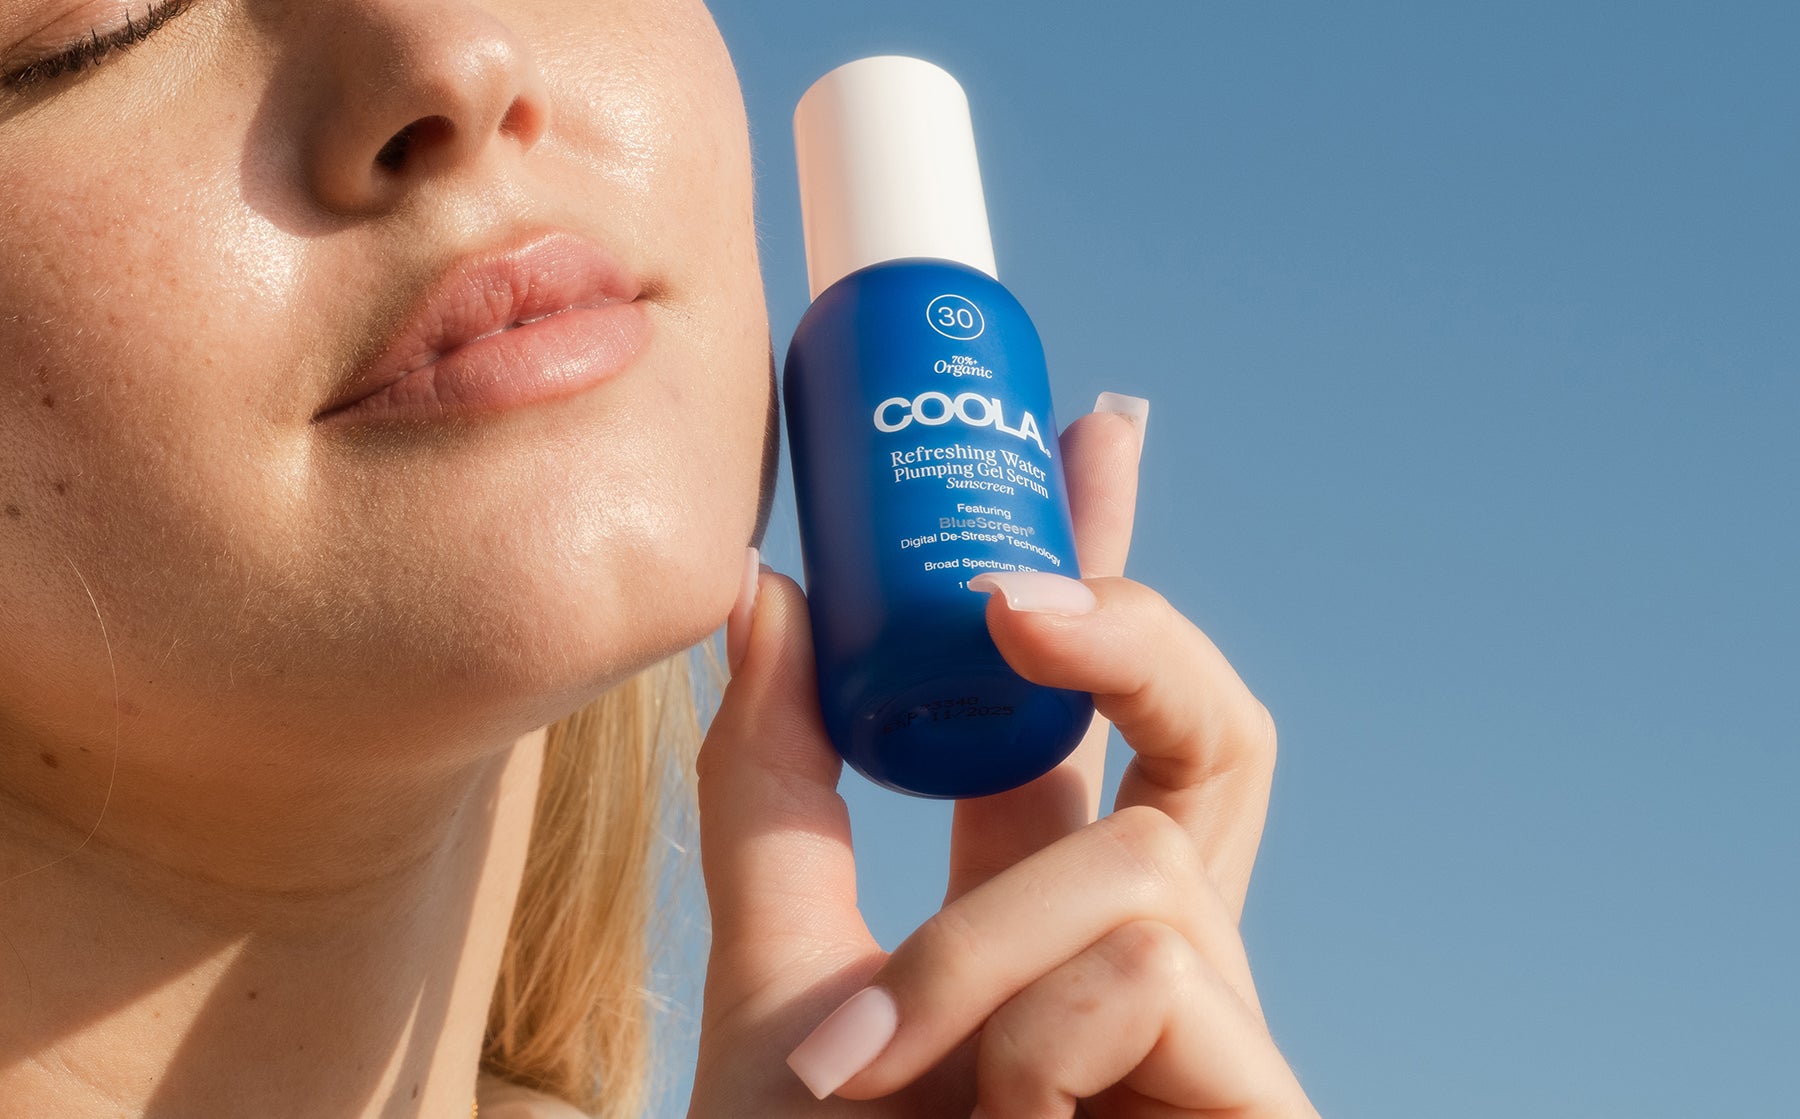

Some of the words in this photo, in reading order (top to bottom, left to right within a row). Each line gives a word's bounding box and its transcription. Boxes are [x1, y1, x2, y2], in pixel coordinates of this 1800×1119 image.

[938, 306, 974, 329] 30
[934, 359, 993, 379] Organic
[890, 443, 998, 468] Refreshing
[999, 449, 1046, 482] Water
[894, 462, 975, 483] Plumping
[977, 462, 1004, 480] Gel
[1006, 468, 1049, 499] Serum
[946, 477, 1015, 496] Sunscreen
[957, 503, 1012, 520] Featuring
[901, 532, 938, 550] Digital
[1006, 535, 1062, 567] Technology
[924, 558, 960, 571] Broad
[962, 557, 1016, 572] Spectrum
